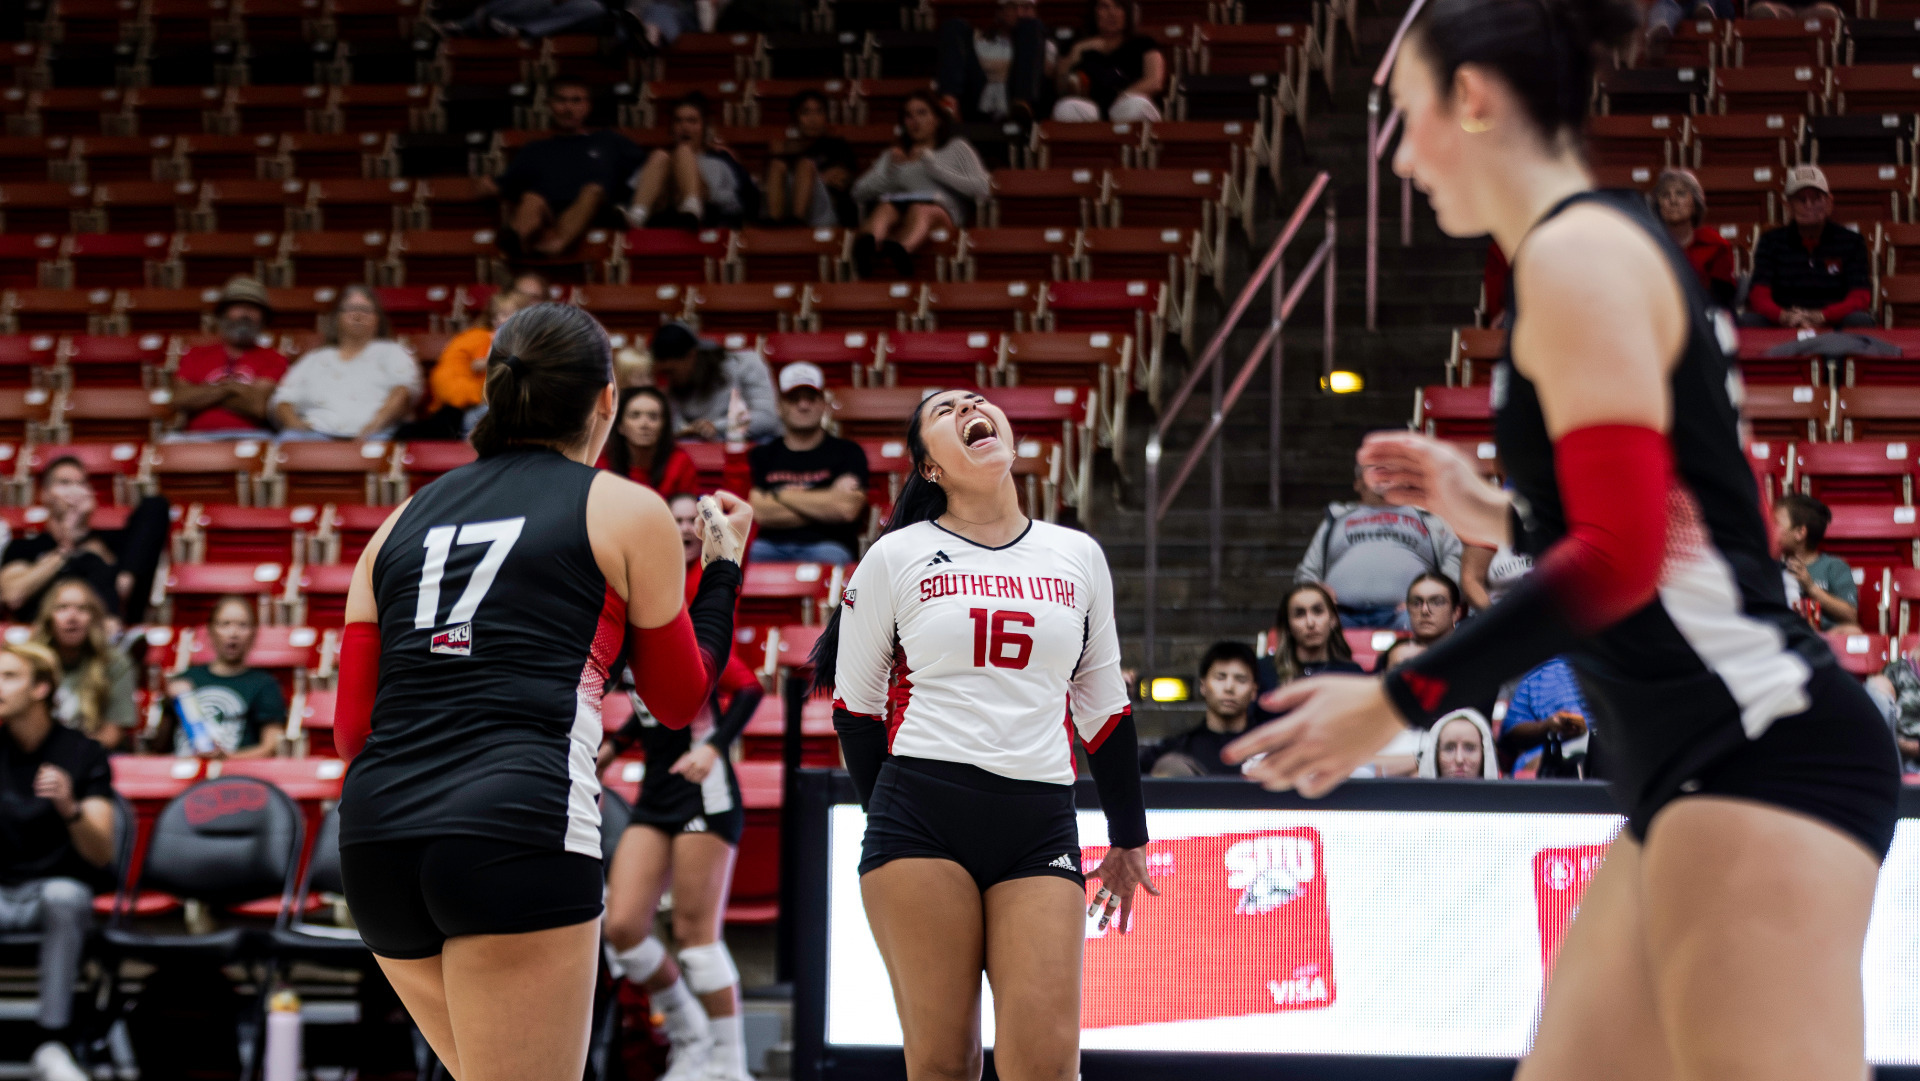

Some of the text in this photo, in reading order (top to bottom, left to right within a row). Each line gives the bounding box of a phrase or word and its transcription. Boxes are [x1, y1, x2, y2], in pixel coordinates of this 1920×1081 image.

[414, 516, 526, 630] 17
[919, 573, 1076, 609] SOUTHERN UTAH
[447, 625, 470, 643] SKY
[969, 607, 1035, 670] 16
[1267, 976, 1328, 1005] VISA
